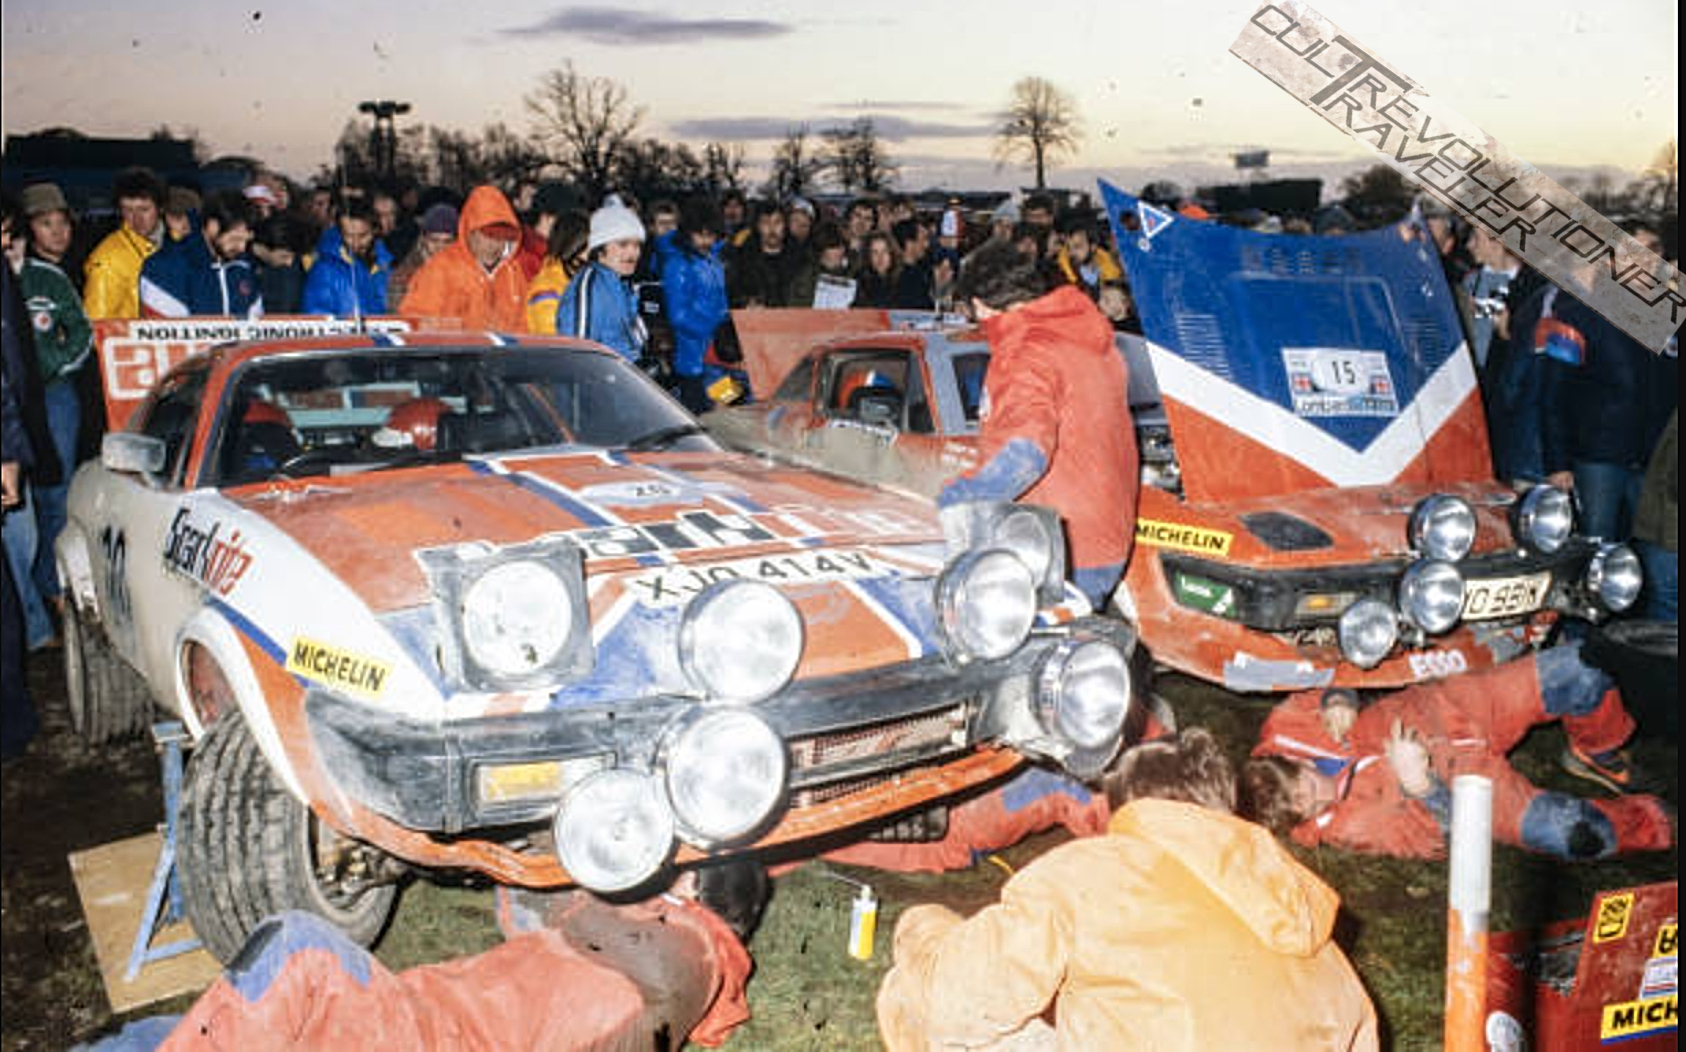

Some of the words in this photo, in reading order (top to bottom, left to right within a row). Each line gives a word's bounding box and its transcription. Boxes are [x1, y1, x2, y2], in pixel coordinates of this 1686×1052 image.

[1332, 361, 1355, 385] 15
[1136, 524, 1224, 549] MICHELIN
[758, 550, 871, 579] 414V
[294, 640, 386, 691] MICHELIN
